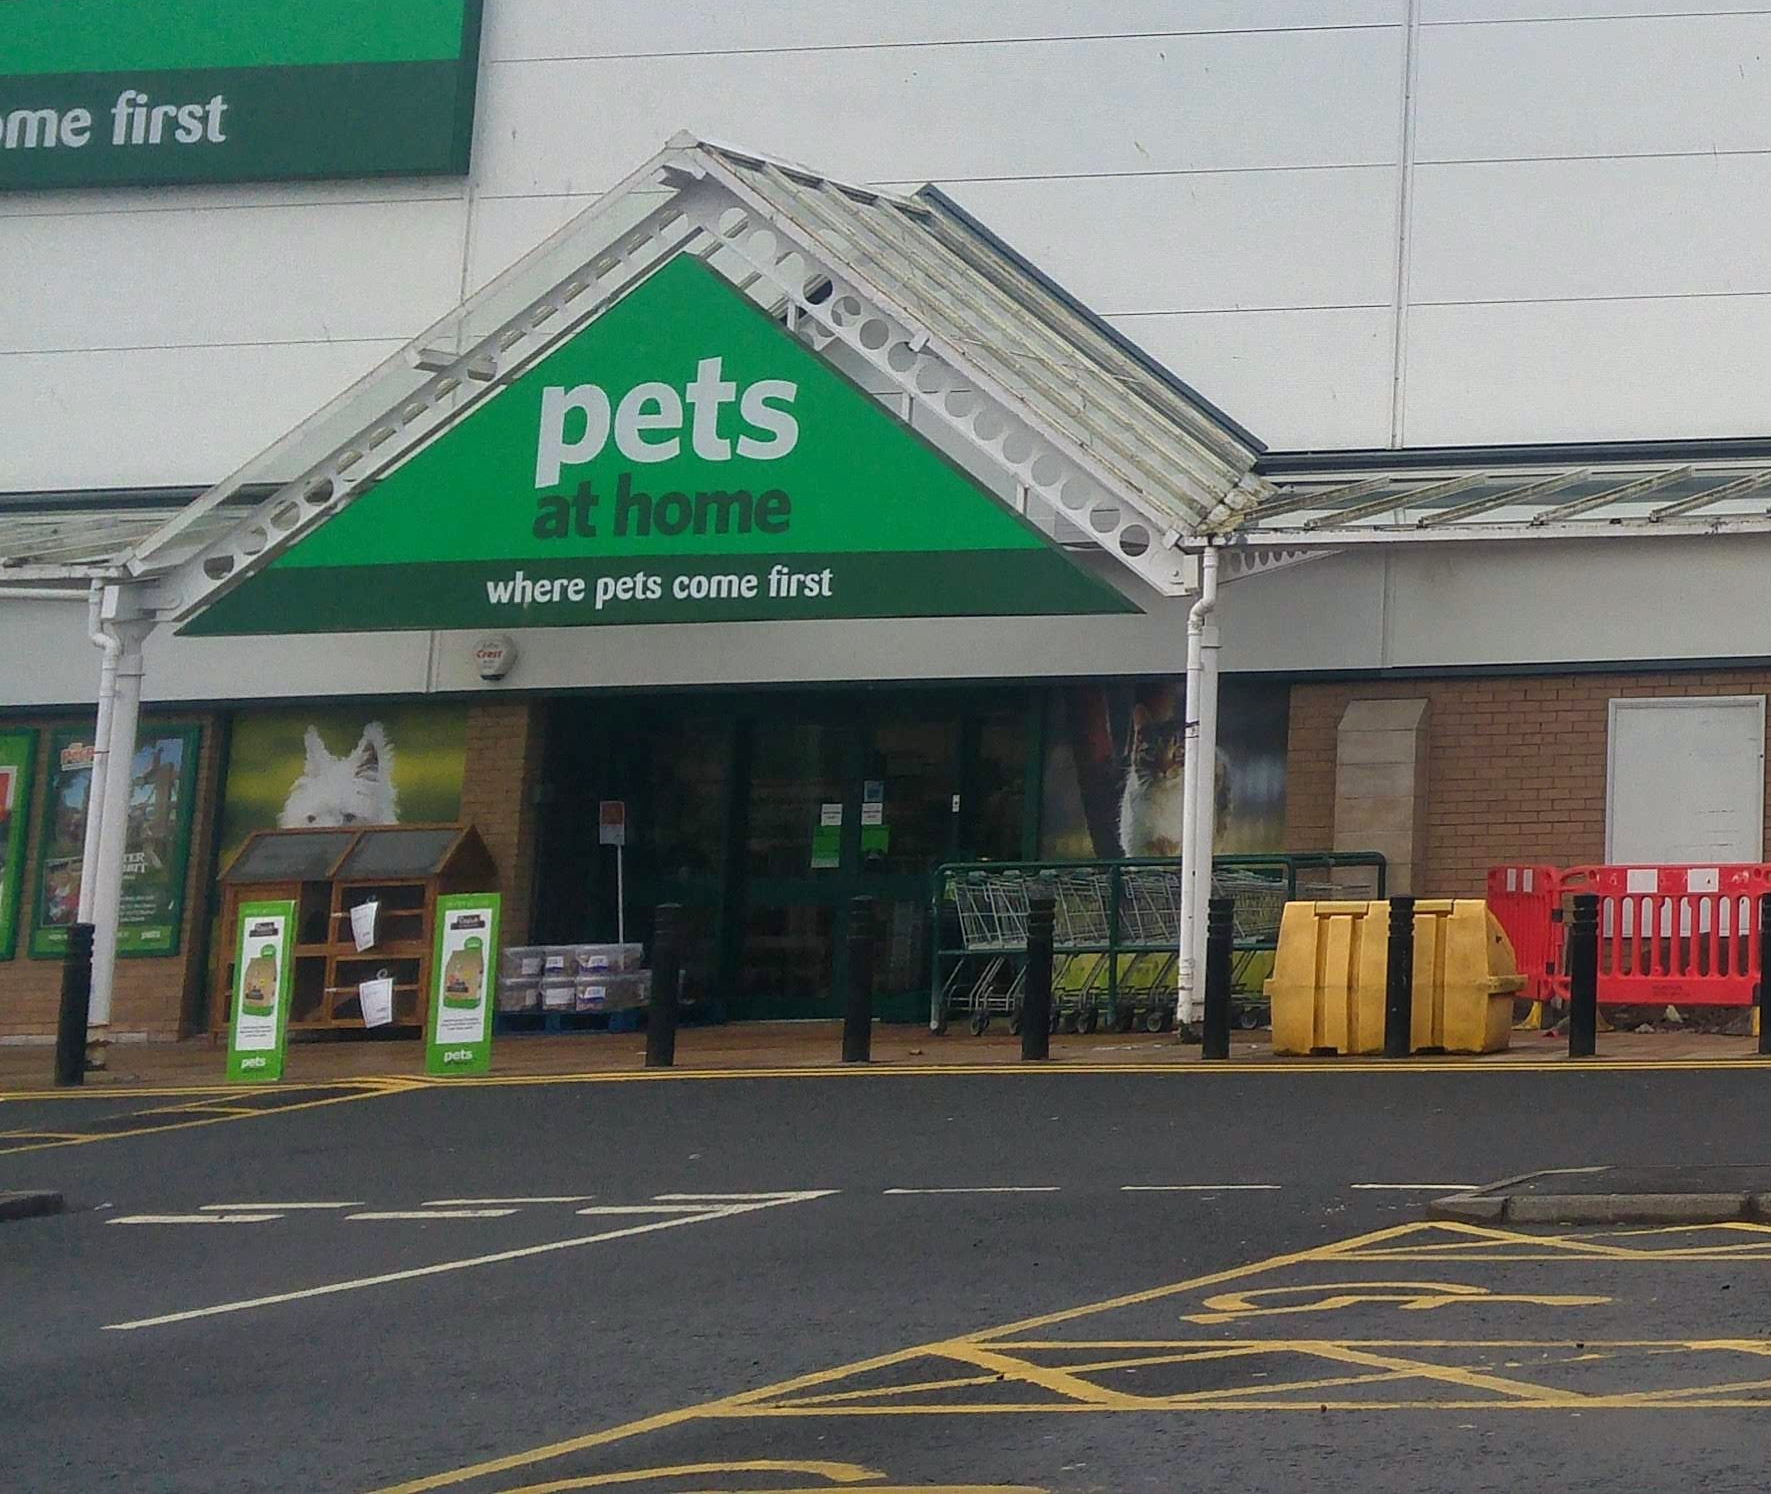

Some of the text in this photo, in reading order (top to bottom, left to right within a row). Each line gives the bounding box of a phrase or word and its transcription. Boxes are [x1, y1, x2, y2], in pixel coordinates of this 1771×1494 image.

[111, 89, 228, 147] first
[534, 356, 800, 489] pets
[533, 472, 791, 540] at home
[487, 564, 833, 610] where pets come first
[444, 1049, 473, 1063] pets
